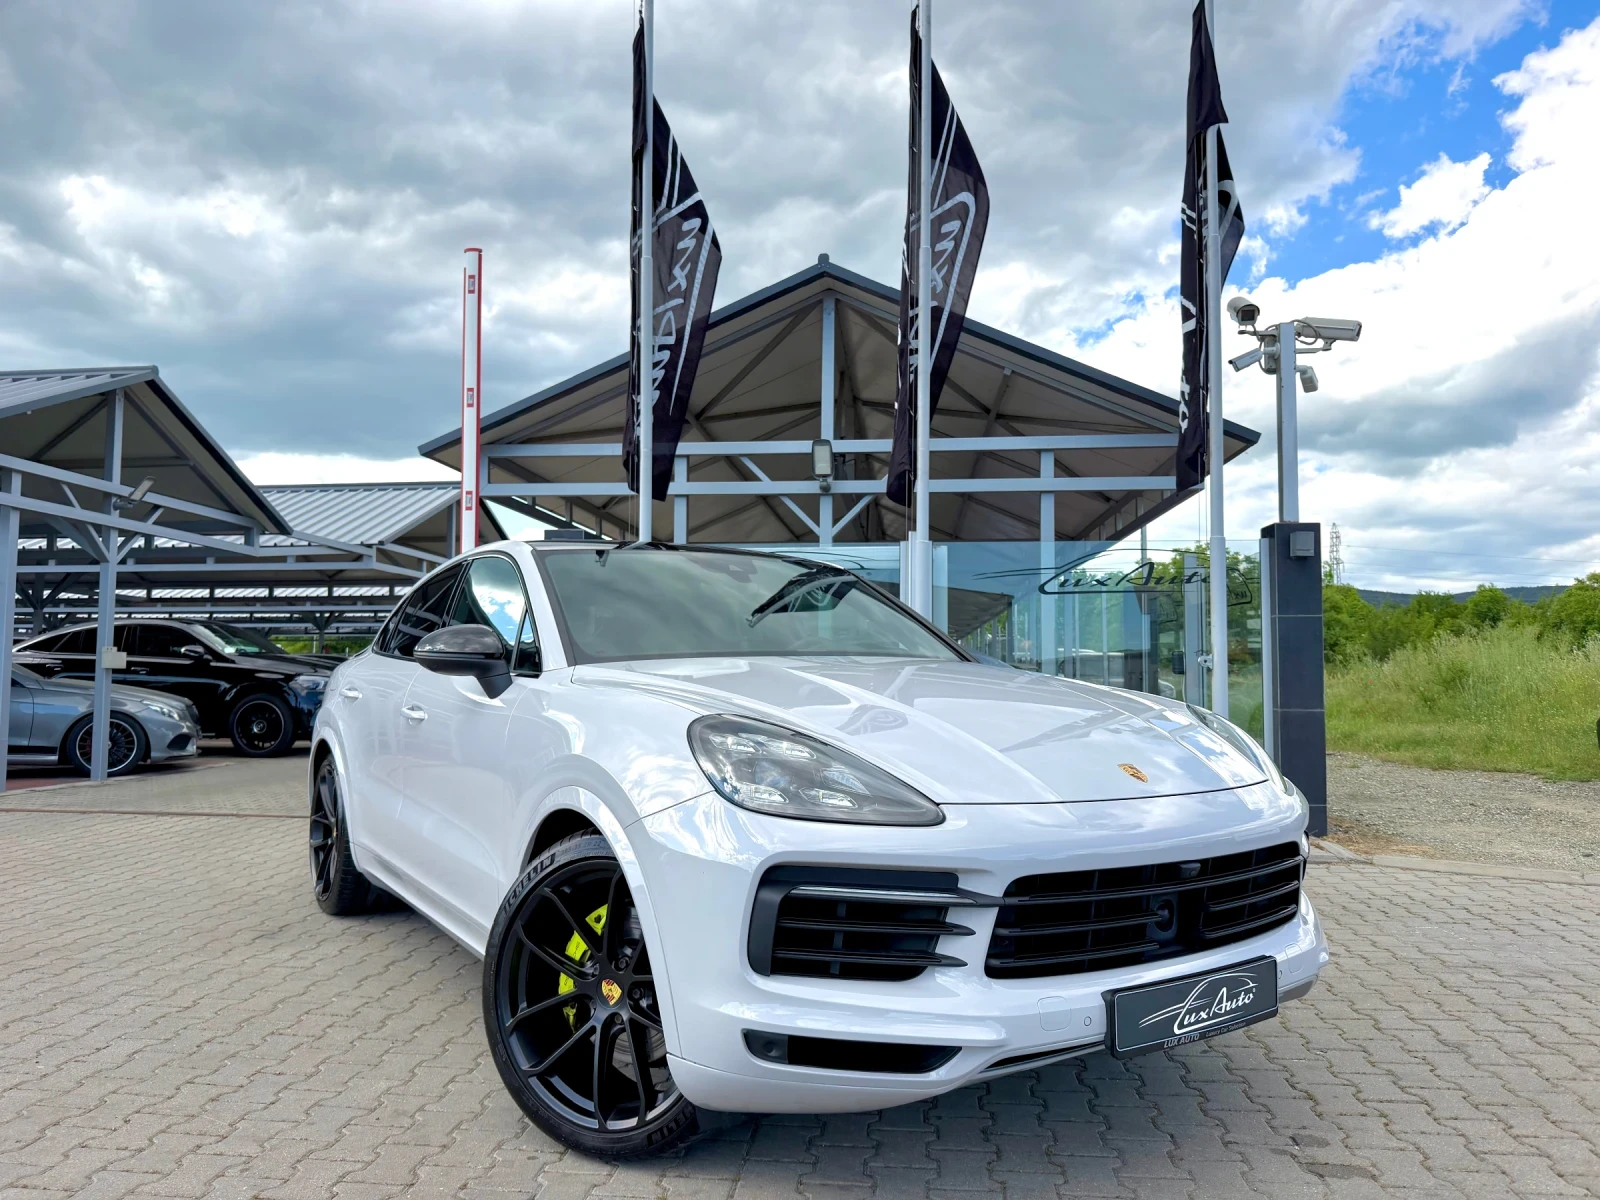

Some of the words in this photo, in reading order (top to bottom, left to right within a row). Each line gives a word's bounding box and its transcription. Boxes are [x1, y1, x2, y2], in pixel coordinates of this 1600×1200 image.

[1210, 986, 1255, 1017] Auto
[1163, 1036, 1179, 1048] LUX
[1179, 1033, 1200, 1045] AUTO
[1205, 1029, 1220, 1037] Luxury
